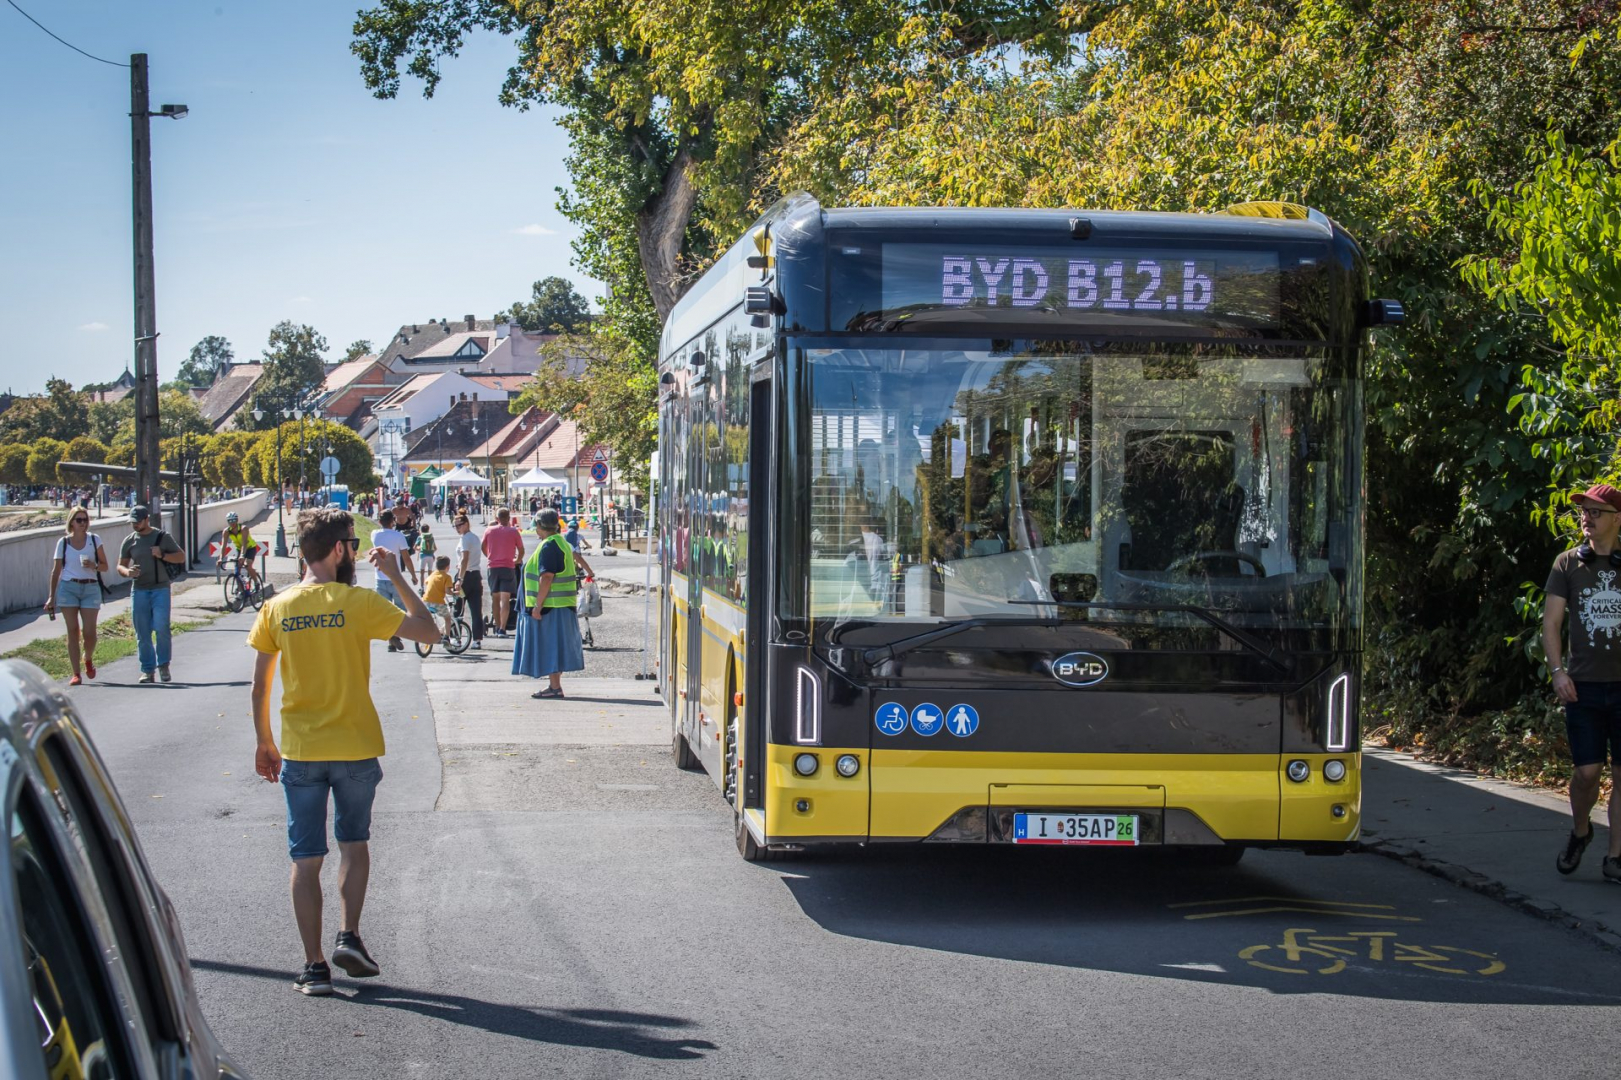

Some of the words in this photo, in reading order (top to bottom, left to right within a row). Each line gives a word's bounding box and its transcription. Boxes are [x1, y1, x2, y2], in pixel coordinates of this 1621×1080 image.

[942, 256, 1049, 306] BYD
[1067, 260, 1212, 311] B12.b
[1591, 604, 1621, 614] MASS
[281, 609, 345, 632] SZERVEZŐ
[1059, 662, 1103, 676] BYD
[1018, 828, 1025, 836] H
[1117, 822, 1132, 835] 26
